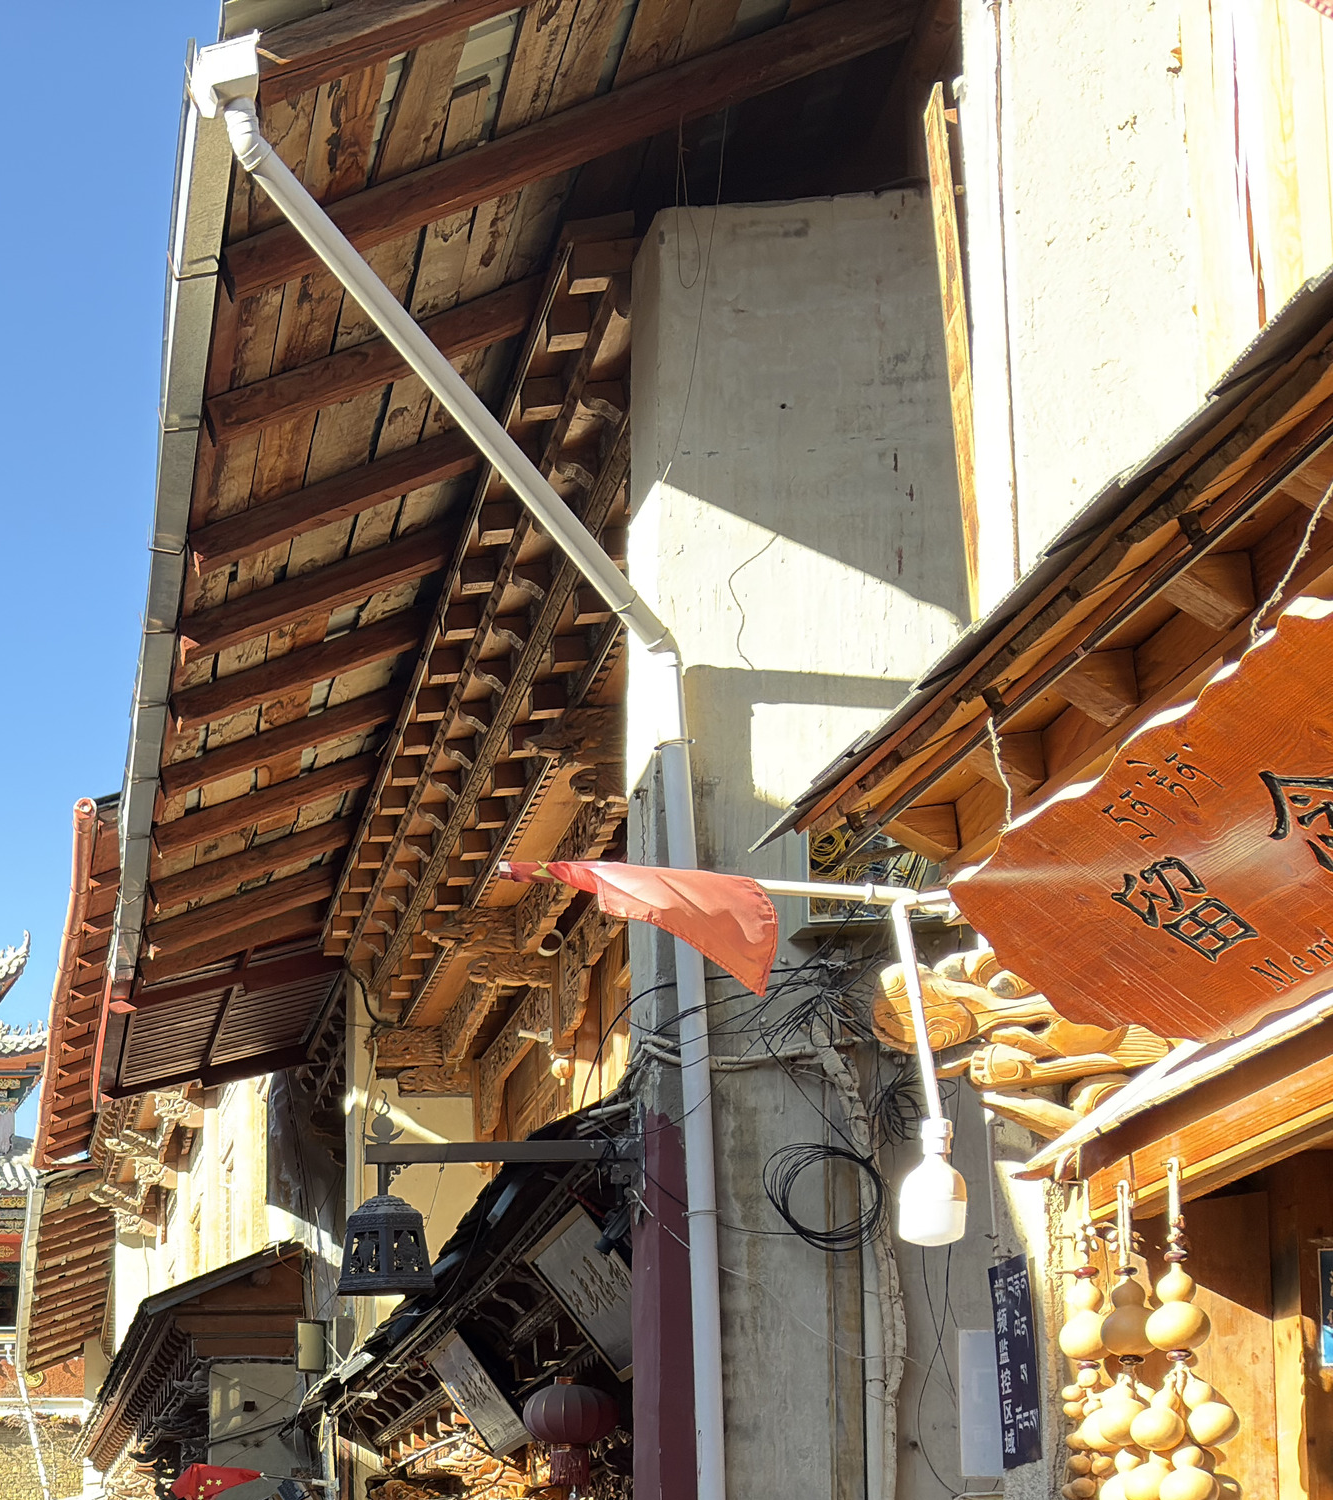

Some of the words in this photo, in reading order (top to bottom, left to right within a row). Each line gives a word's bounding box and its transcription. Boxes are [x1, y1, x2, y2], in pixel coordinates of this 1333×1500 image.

[994, 1277, 1017, 1455] 视频监控区域
